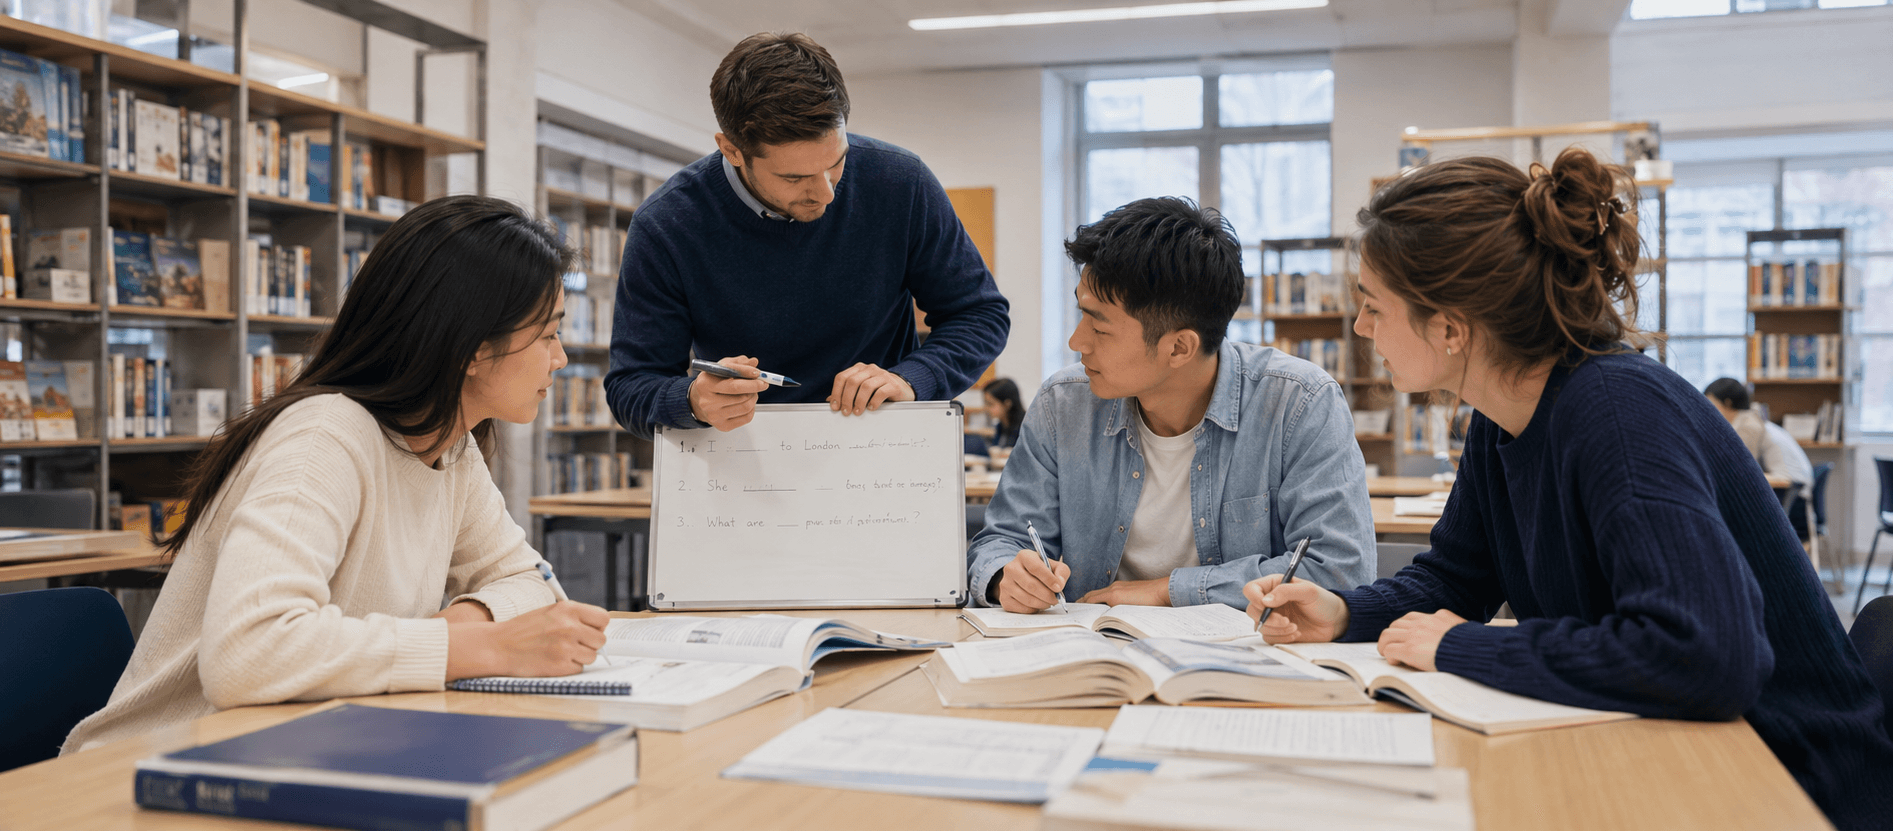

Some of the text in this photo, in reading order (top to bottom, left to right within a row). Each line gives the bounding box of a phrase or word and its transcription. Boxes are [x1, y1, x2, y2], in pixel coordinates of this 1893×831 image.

[707, 440, 716, 452] I
[780, 440, 792, 451] to
[804, 439, 841, 451] London
[678, 480, 692, 492] 2.
[707, 479, 728, 492] She
[706, 516, 736, 528] What
[746, 519, 765, 528] are
